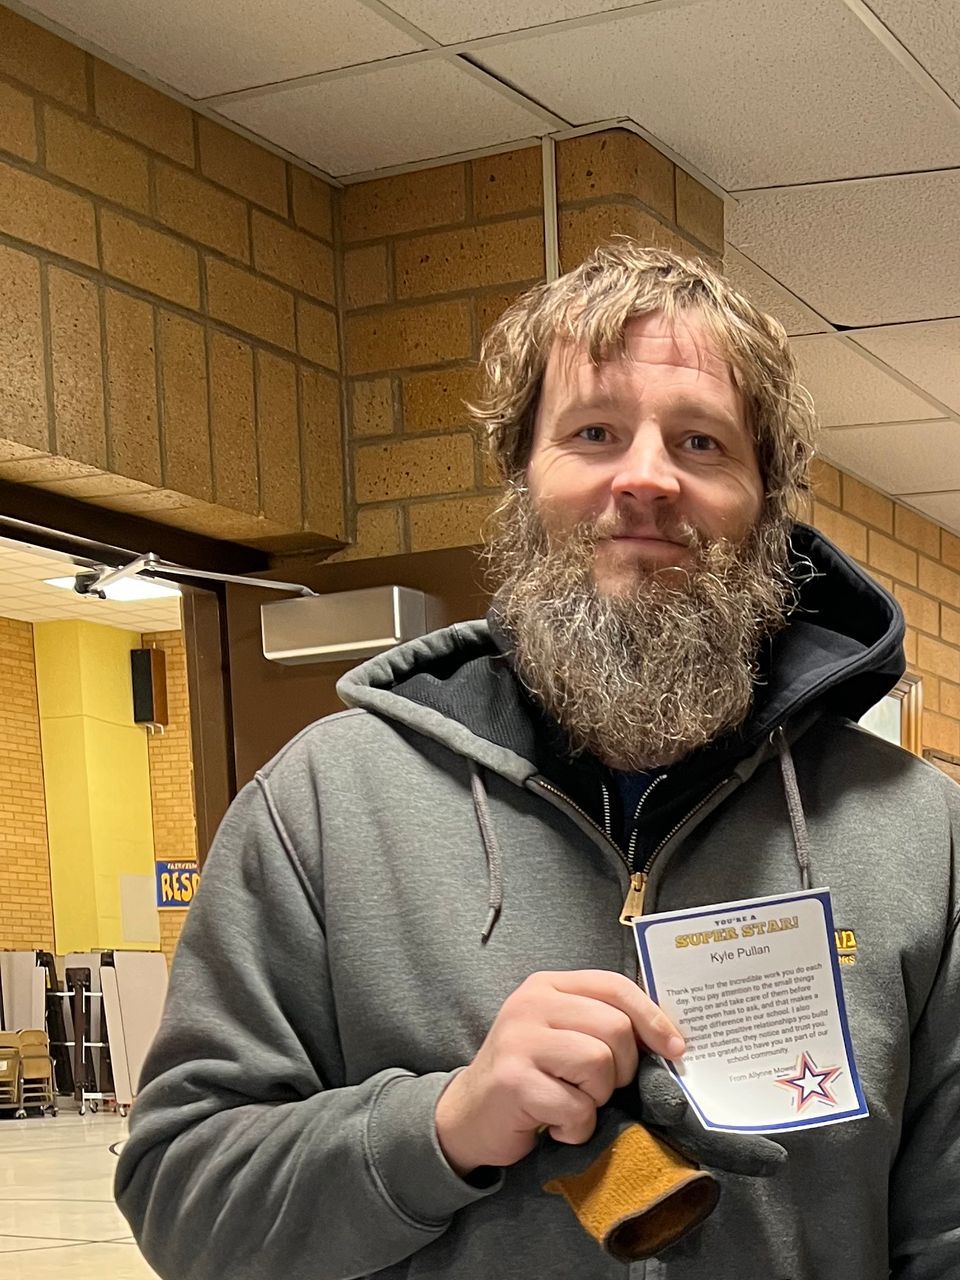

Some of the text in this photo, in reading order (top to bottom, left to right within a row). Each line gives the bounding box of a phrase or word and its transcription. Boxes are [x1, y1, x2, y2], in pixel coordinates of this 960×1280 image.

[715, 916, 747, 926] YOU'RE
[675, 916, 799, 948] SUPER STAR!
[711, 946, 770, 964] Kyle Pullan
[666, 988, 689, 996] Thank
[690, 986, 703, 994] you
[782, 970, 794, 978] you
[806, 963, 822, 971] each
[774, 978, 792, 987] small
[794, 975, 814, 983] things
[679, 1015, 704, 1024] anyone
[761, 1001, 774, 1009] and
[790, 995, 813, 1003] makes
[683, 1006, 703, 1016] going
[715, 1000, 728, 1008] and
[789, 986, 811, 994] before
[684, 1033, 711, 1043] preciate
[726, 1026, 752, 1036] positive
[754, 1017, 797, 1029] relationships
[798, 1015, 810, 1023] you
[811, 1009, 828, 1019] build
[690, 1024, 708, 1032] huge
[709, 1018, 744, 1029] difference
[759, 1030, 780, 1038] notice
[781, 1026, 794, 1034] and
[795, 1023, 811, 1032] trust
[717, 1045, 743, 1057] grateful
[753, 1041, 769, 1049] have
[771, 1039, 783, 1047] you
[794, 1033, 808, 1042] part
[727, 1054, 749, 1064] school
